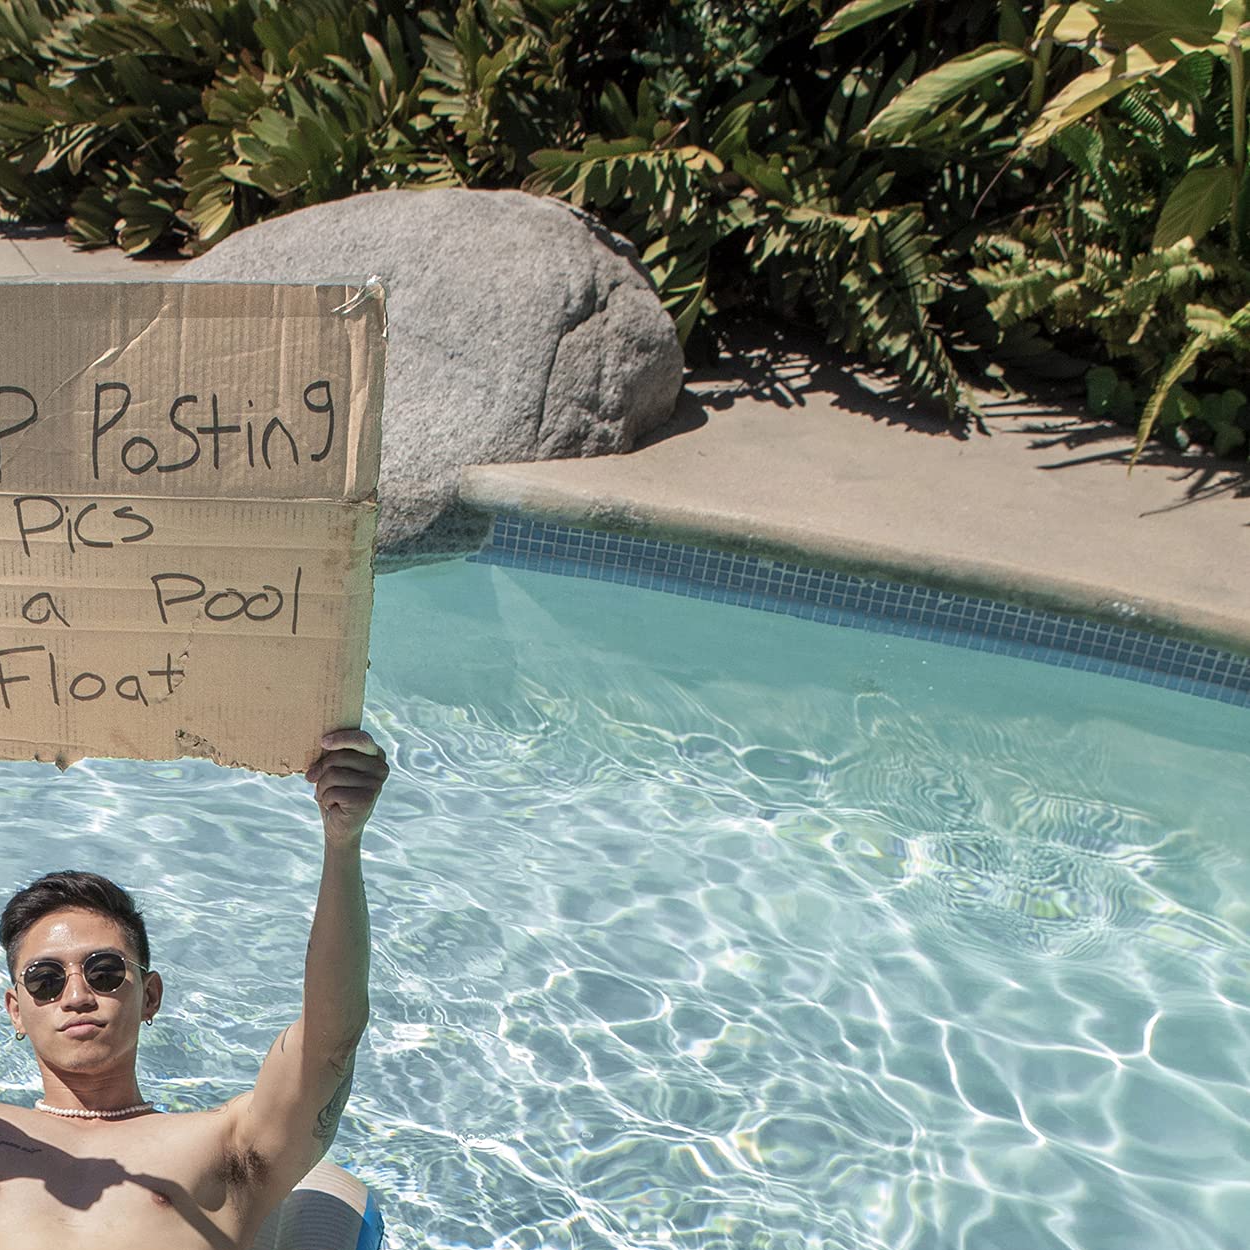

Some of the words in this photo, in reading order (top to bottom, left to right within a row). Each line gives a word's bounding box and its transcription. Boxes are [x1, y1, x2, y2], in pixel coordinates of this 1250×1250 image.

[13, 495, 154, 557] Pics
[21, 591, 70, 628] a
[151, 566, 301, 634] Pool
